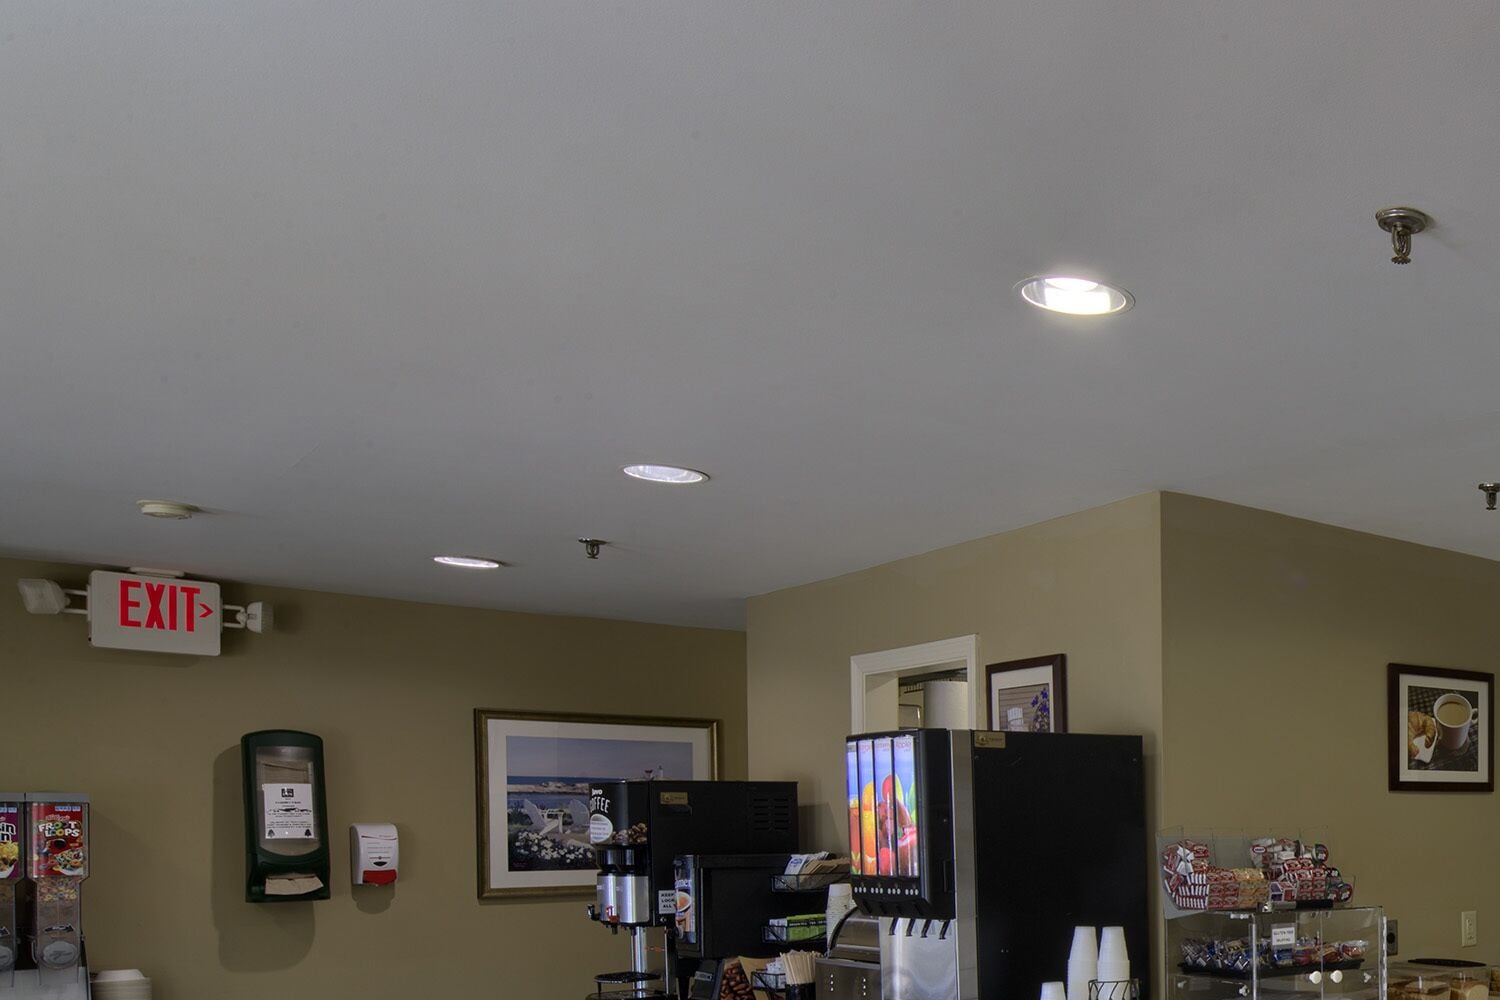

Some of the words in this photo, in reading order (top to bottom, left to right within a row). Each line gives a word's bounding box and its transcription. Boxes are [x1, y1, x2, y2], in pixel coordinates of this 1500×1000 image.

[120, 580, 200, 632] EXIT
[590, 797, 611, 813] OFFEE
[38, 821, 78, 832] FROOT
[45, 828, 81, 837] LOOPS
